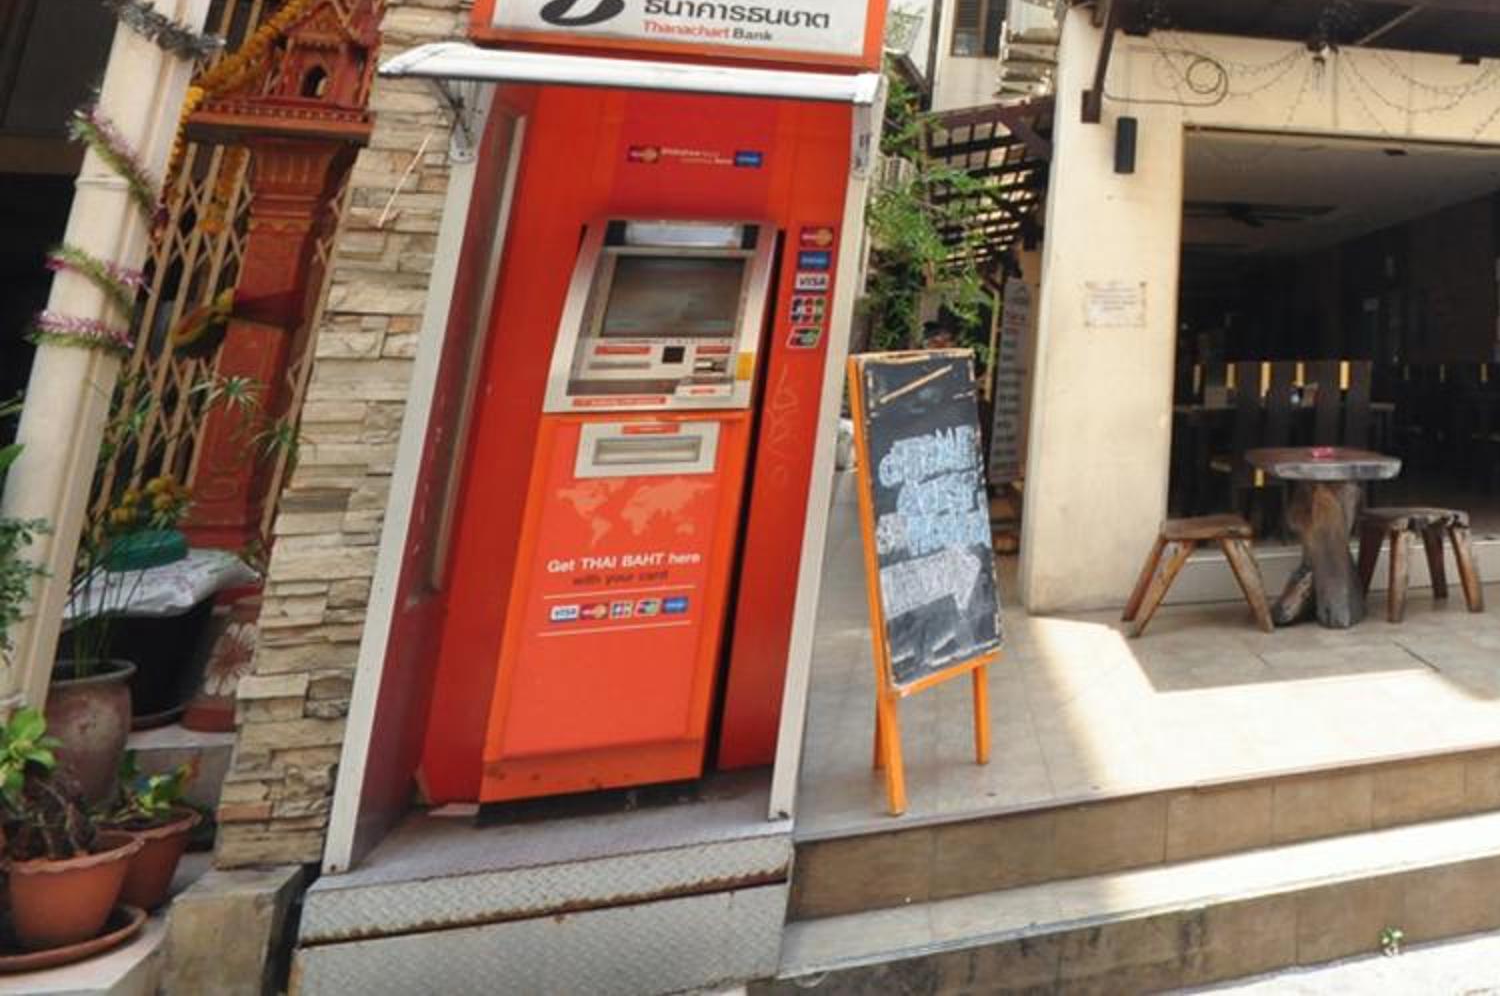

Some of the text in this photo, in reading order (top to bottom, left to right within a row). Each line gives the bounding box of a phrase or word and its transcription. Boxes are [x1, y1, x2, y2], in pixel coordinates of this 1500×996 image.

[643, 20, 773, 42] Thanachart Bank
[546, 558, 577, 573] Get
[580, 555, 618, 571] THAI
[621, 552, 666, 568] BAHT
